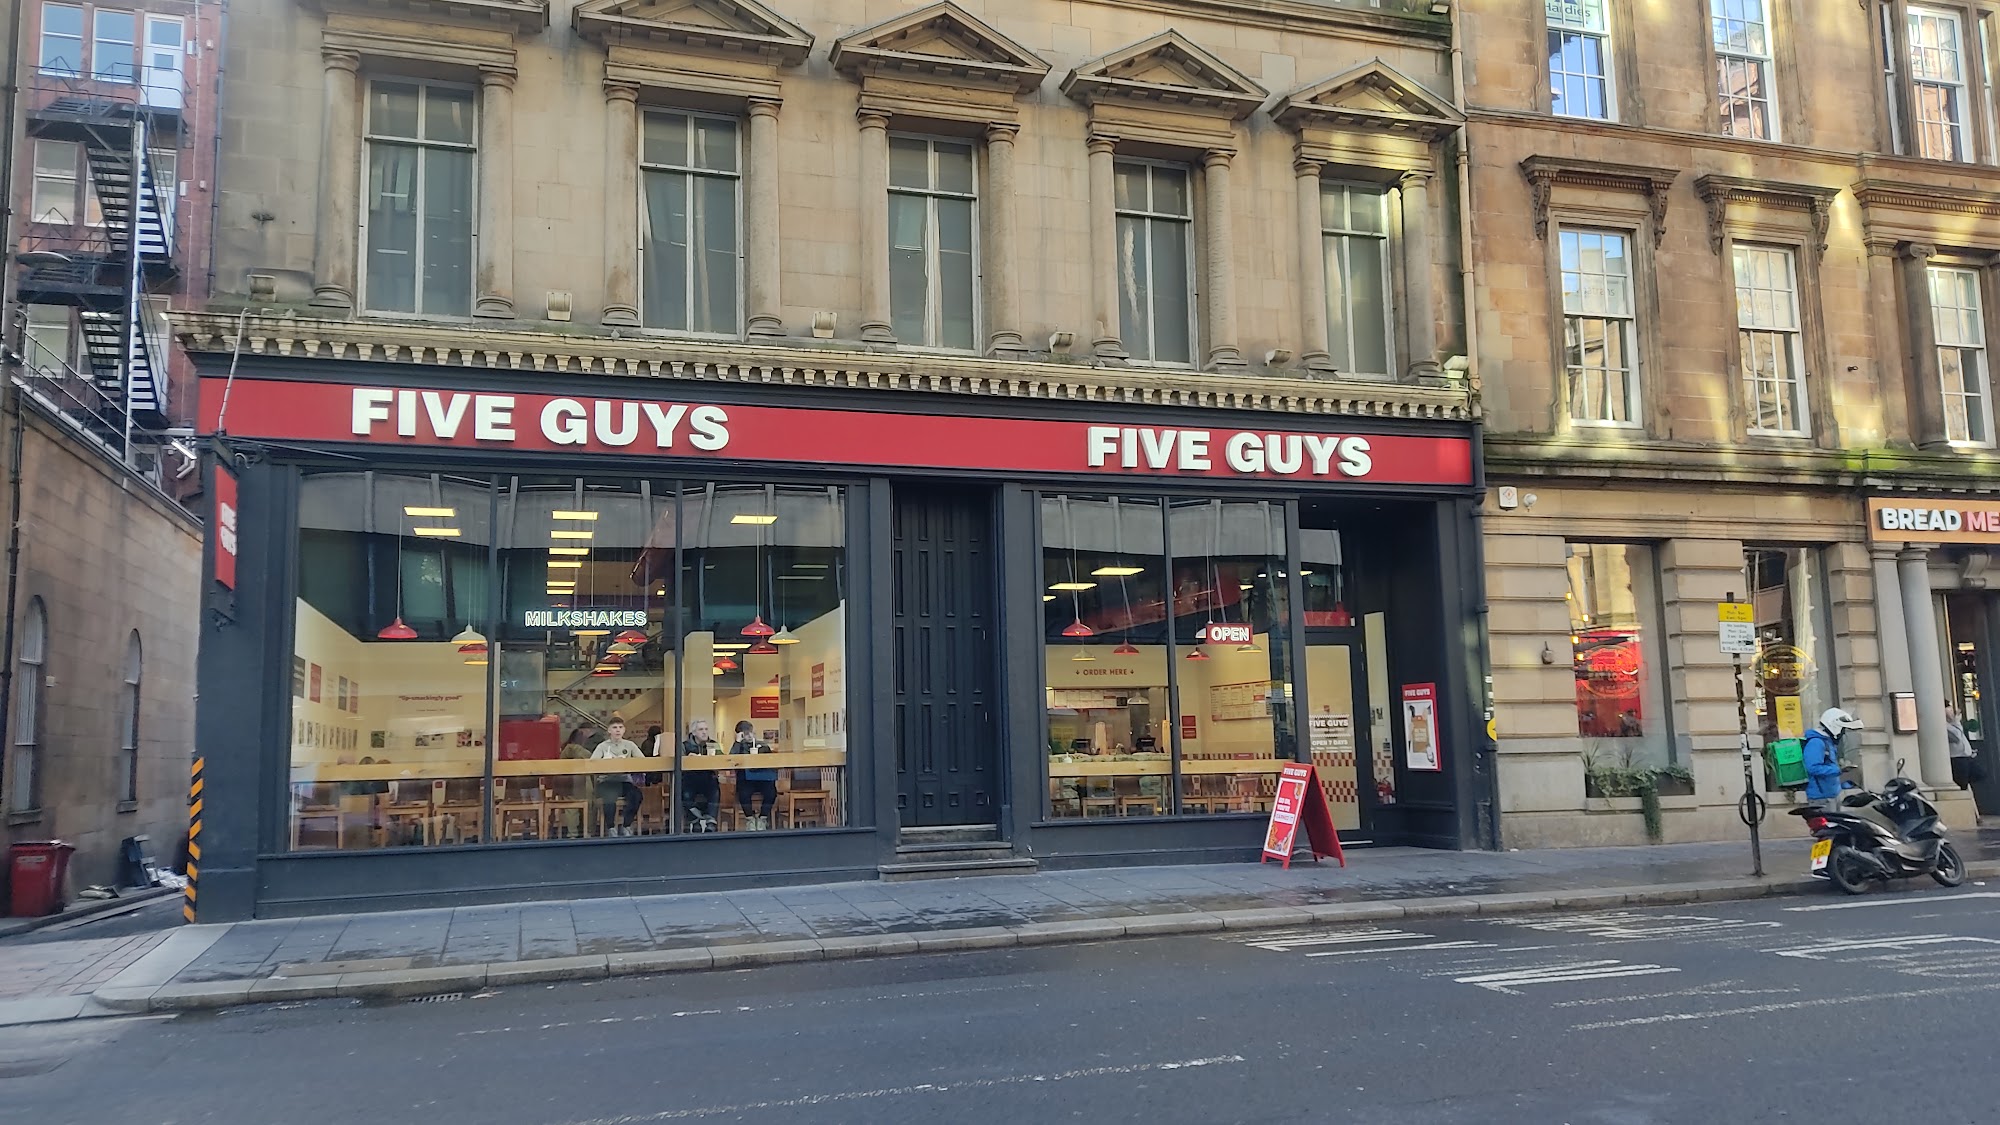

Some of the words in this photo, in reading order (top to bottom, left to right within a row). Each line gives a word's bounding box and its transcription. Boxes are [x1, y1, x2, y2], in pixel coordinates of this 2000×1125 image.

[1545, 3, 1591, 17] Hadies
[352, 388, 516, 441] FIVE
[540, 398, 730, 451] GUYS
[1088, 426, 1212, 471] FIVE
[1225, 432, 1373, 477] GUYS
[1879, 507, 1962, 532] BREAD
[524, 610, 647, 627] MILKSHAKES
[1211, 626, 1250, 642] OPEN
[1309, 719, 1326, 728] FIVE
[1327, 719, 1349, 728] GUYS
